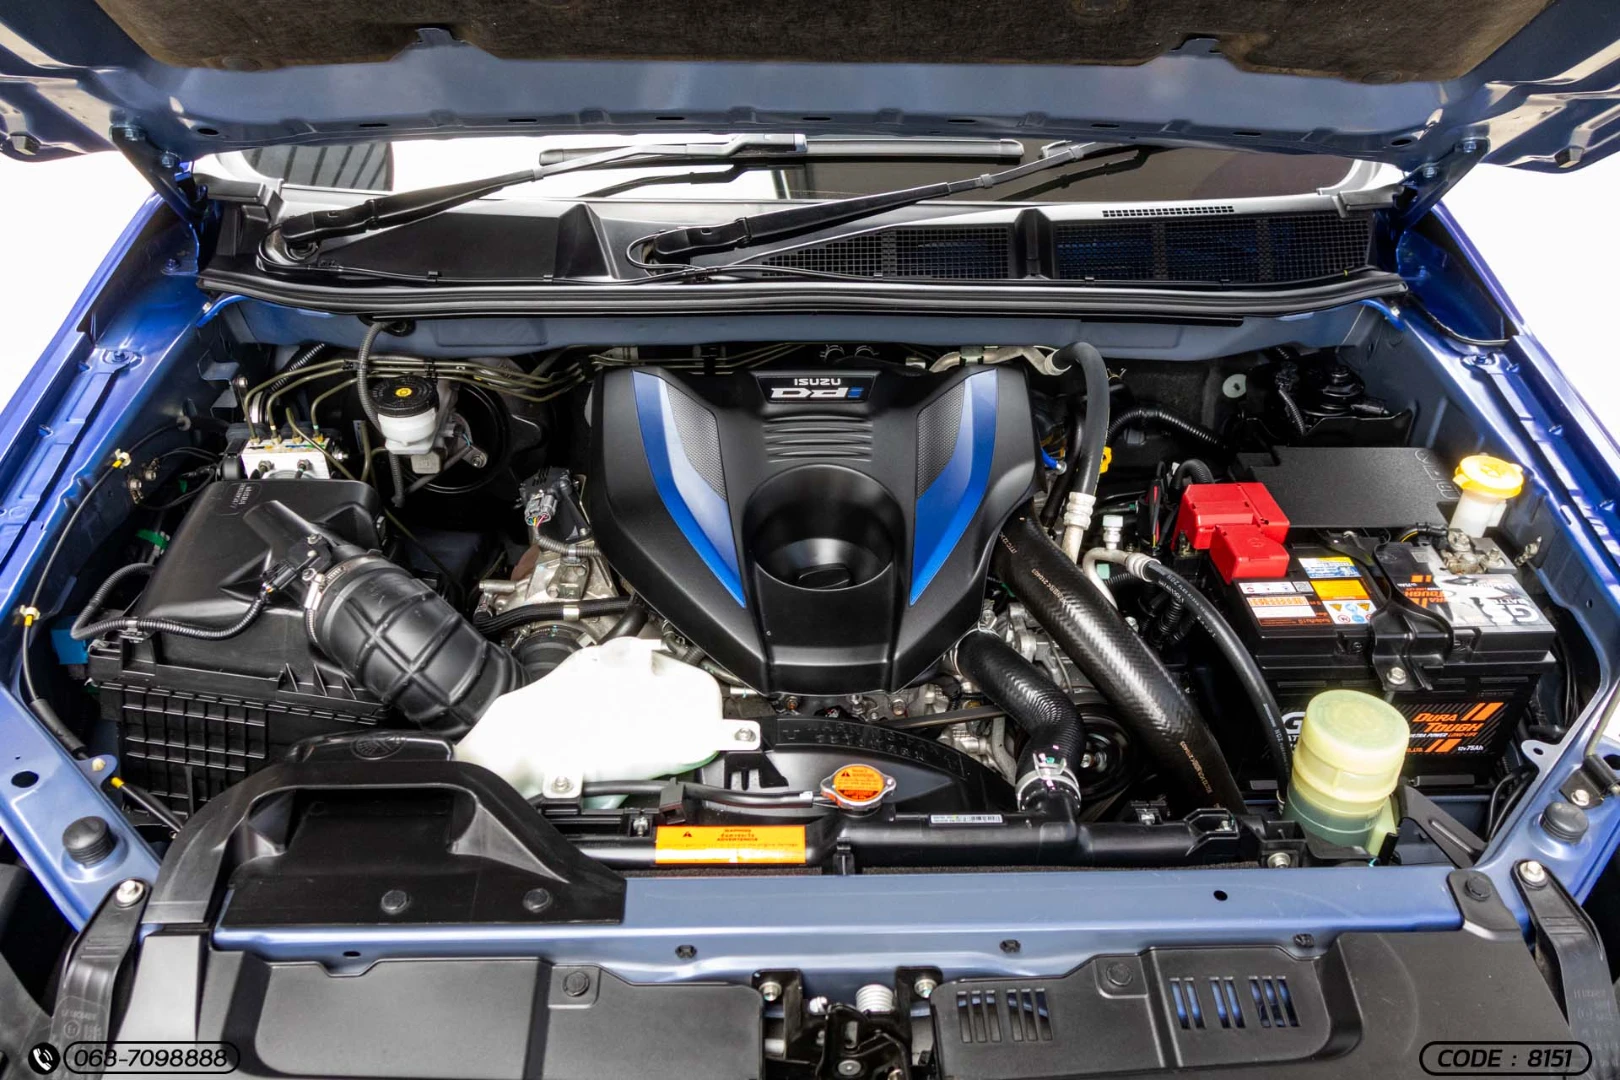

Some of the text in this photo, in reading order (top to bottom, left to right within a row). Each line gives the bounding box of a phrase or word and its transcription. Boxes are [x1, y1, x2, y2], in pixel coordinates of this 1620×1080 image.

[794, 378, 841, 386] ISUZU
[1412, 713, 1458, 722] DURA
[1424, 723, 1484, 732] TOUGH
